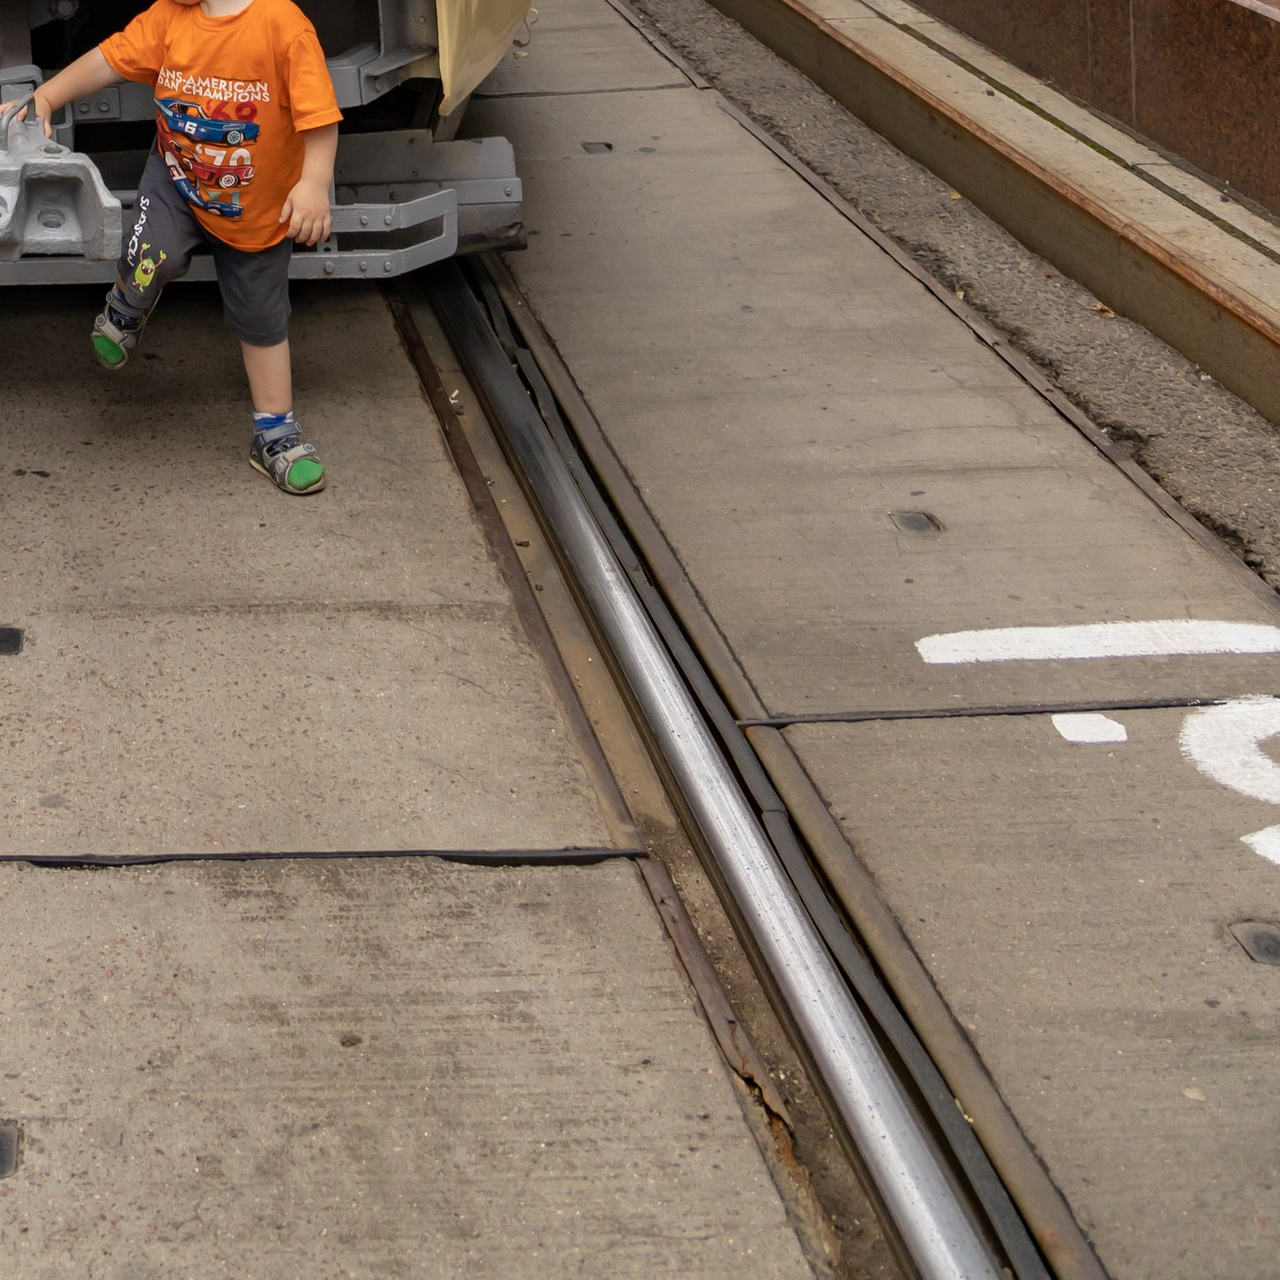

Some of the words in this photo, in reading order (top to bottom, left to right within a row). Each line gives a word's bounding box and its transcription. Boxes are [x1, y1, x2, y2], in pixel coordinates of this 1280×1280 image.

[157, 75, 180, 92] DAN
[182, 84, 271, 103] CHAMPIONS
[158, 66, 269, 94] ANS-AMERICAN
[184, 121, 198, 135] 6
